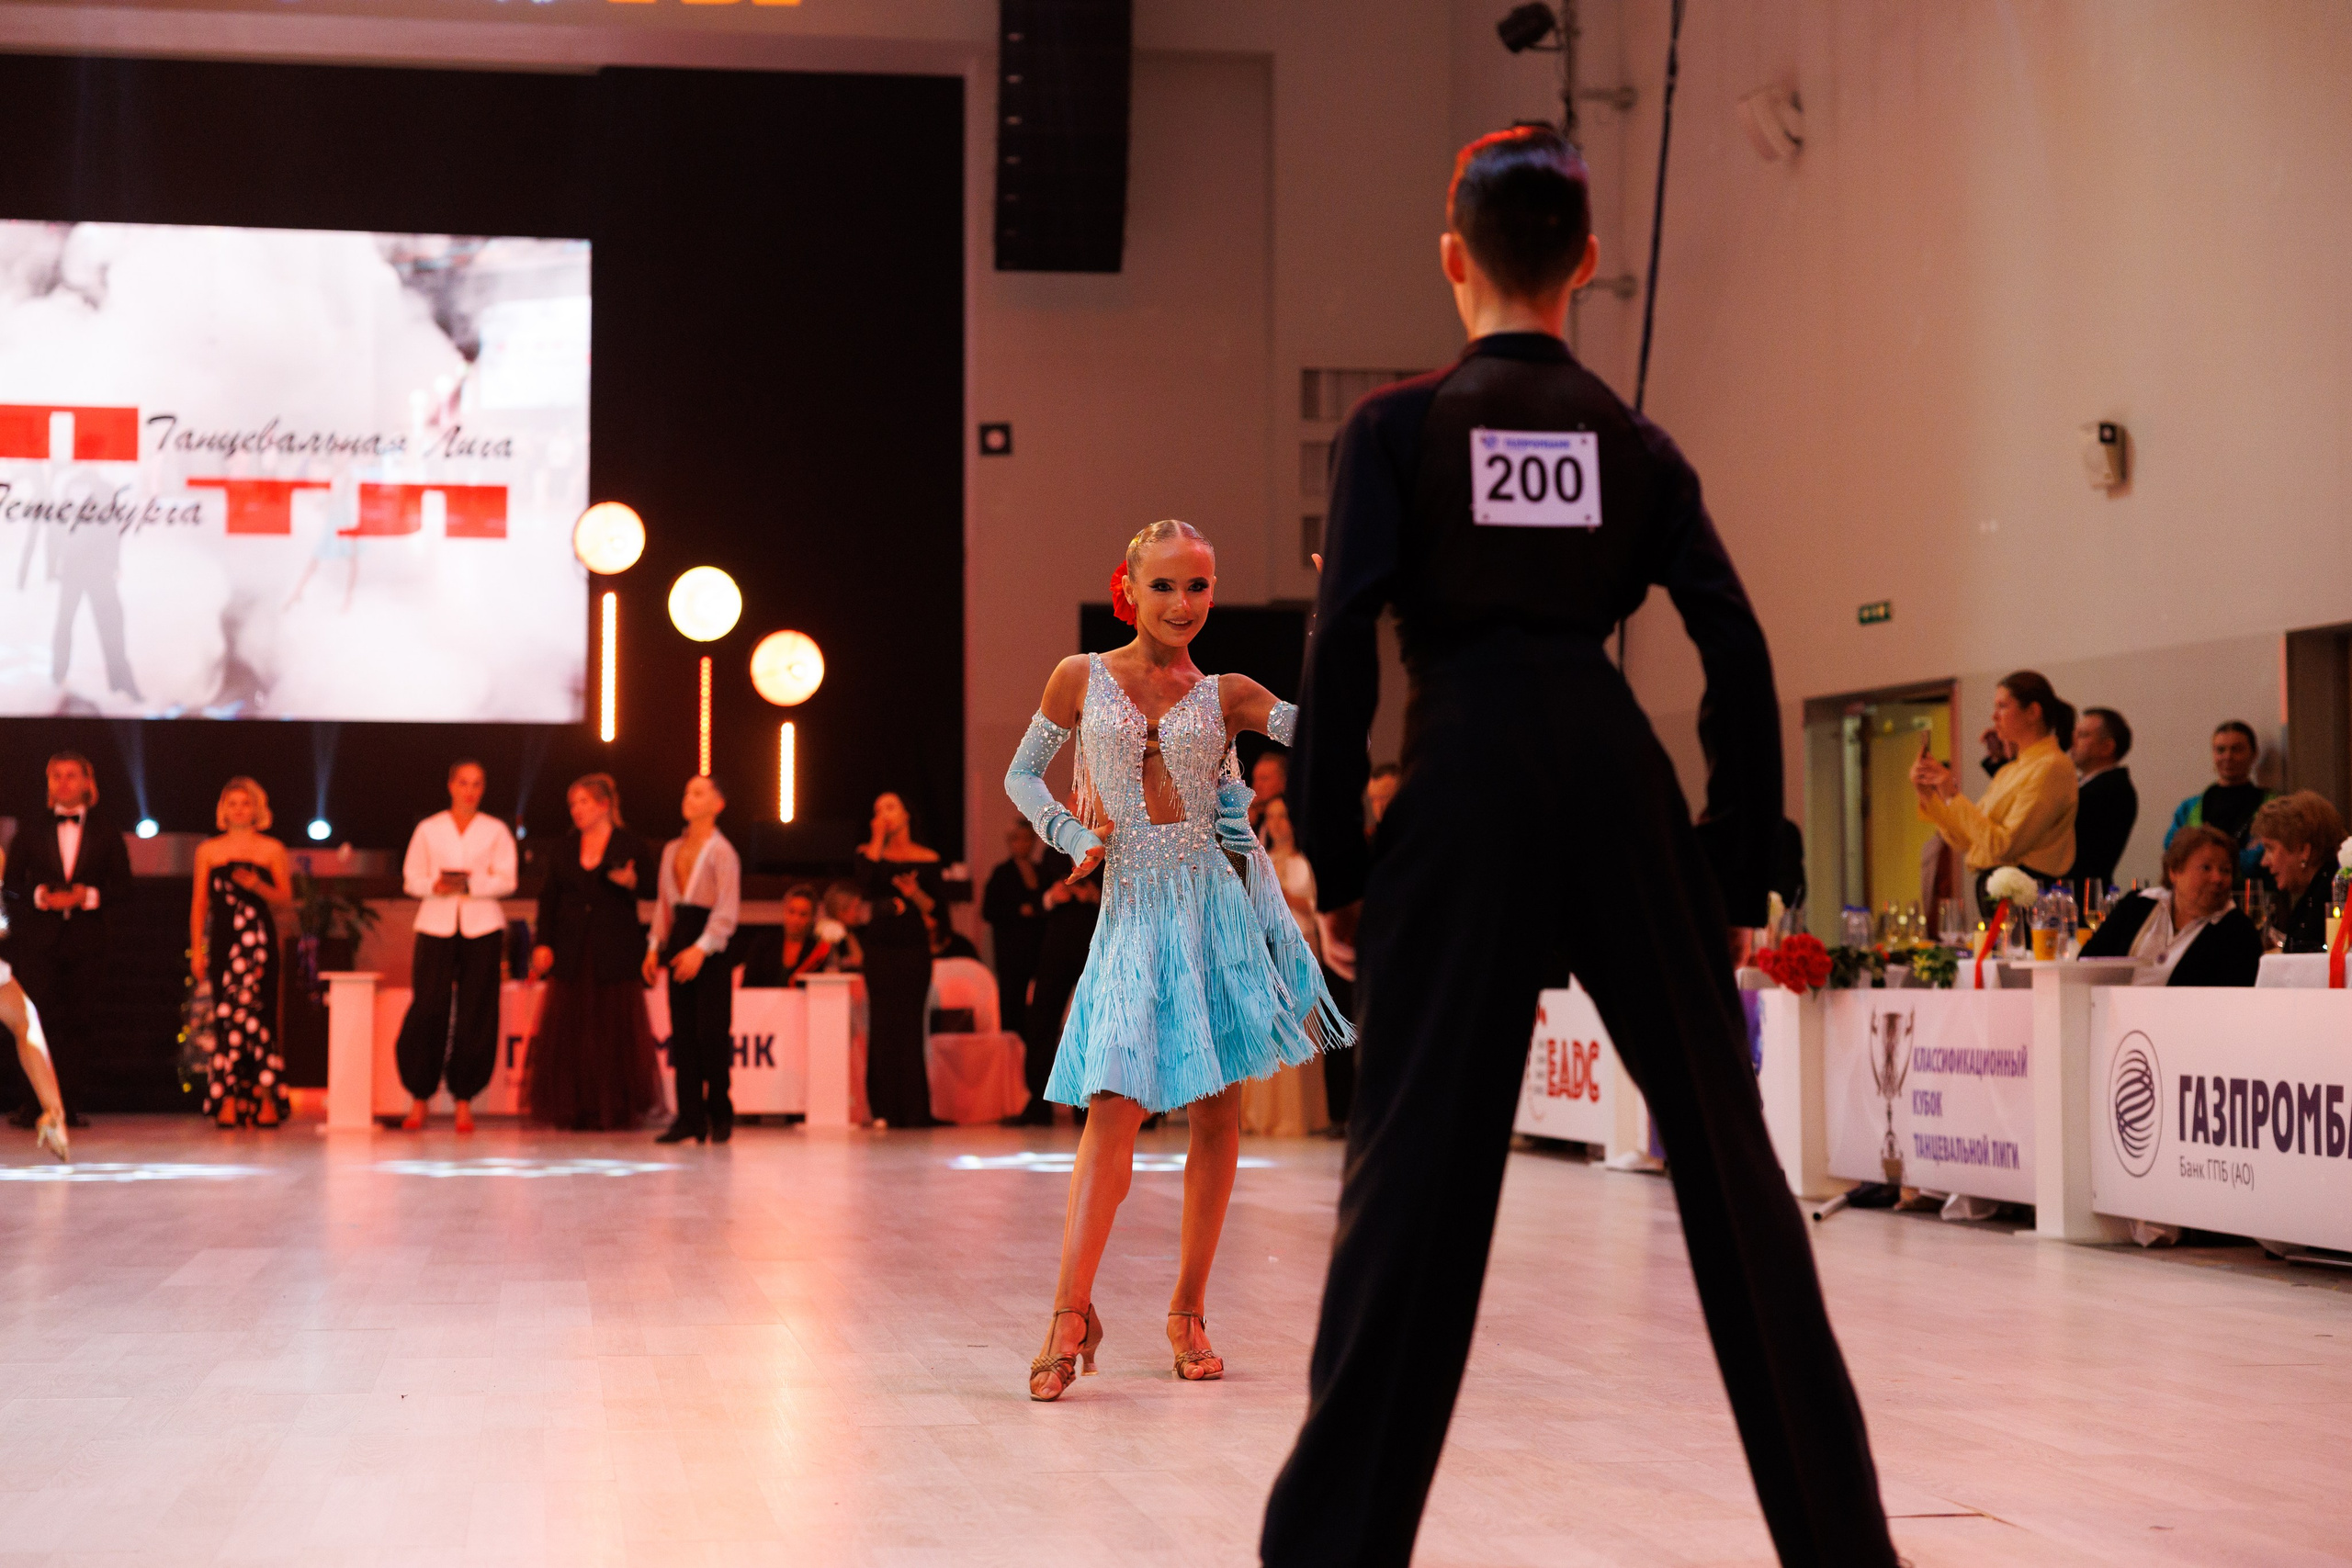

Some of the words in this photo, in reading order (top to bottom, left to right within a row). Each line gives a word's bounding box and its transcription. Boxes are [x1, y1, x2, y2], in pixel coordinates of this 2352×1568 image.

[146, 414, 407, 457] Танцевальная
[422, 424, 514, 459] Лига
[1487, 455, 1583, 503] 200
[1913, 1045, 2029, 1081] КЛАССИФИКАЦИОННЫЙ
[1913, 1089, 1943, 1117] КУБОК
[2178, 1074, 2352, 1160] ГАЗПРОМБ
[1913, 1132, 1990, 1168] ТАНЦЕВАЛЬНОЙ
[1992, 1139, 2020, 1170] ЛИГИ
[2179, 1156, 2205, 1179] Банк
[2207, 1158, 2229, 1183] ГПБ
[2231, 1162, 2256, 1191] (АО)
